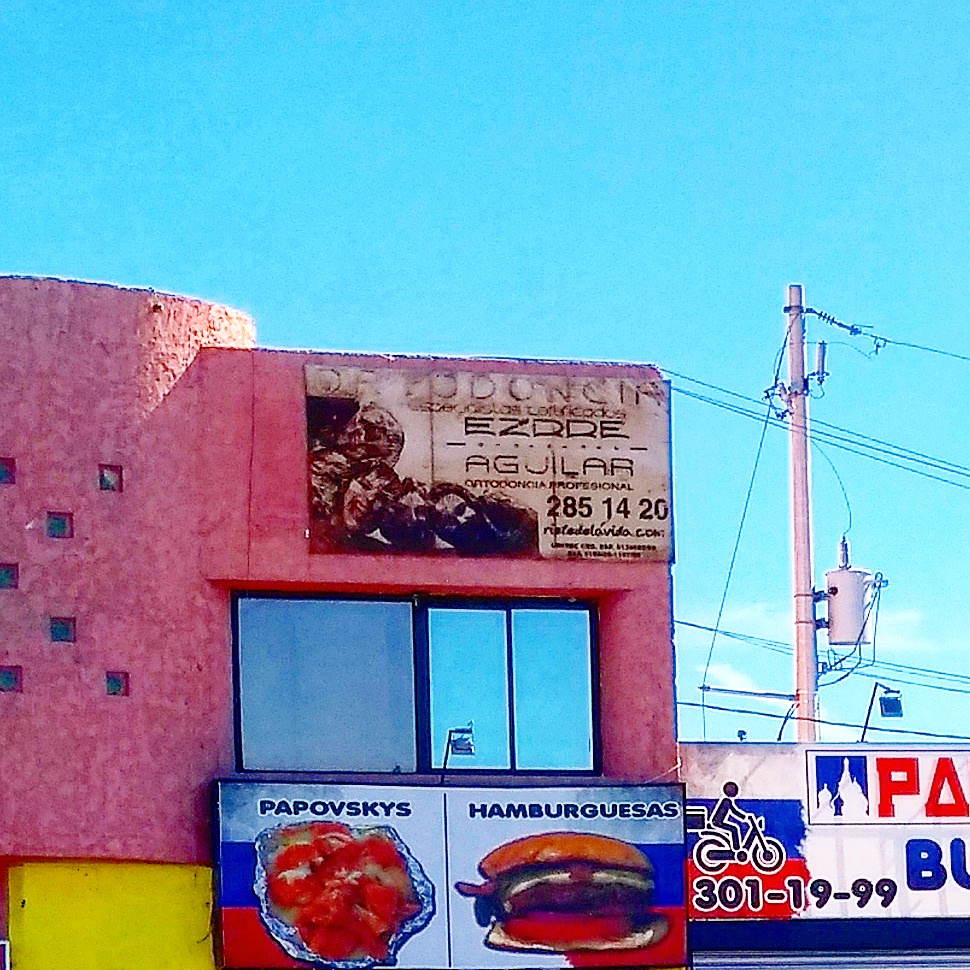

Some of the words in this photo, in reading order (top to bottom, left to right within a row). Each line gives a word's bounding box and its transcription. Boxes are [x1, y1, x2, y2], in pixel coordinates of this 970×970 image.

[465, 455, 634, 477] AGUILAR
[464, 479, 546, 490] ORTODONCIA
[546, 495, 593, 518] 285
[602, 497, 630, 519] 14
[639, 498, 668, 520] 20
[259, 799, 412, 817] PAPOVSKYS
[468, 803, 679, 819] HAMBURGUESAS
[695, 877, 898, 910] 301-19-99
